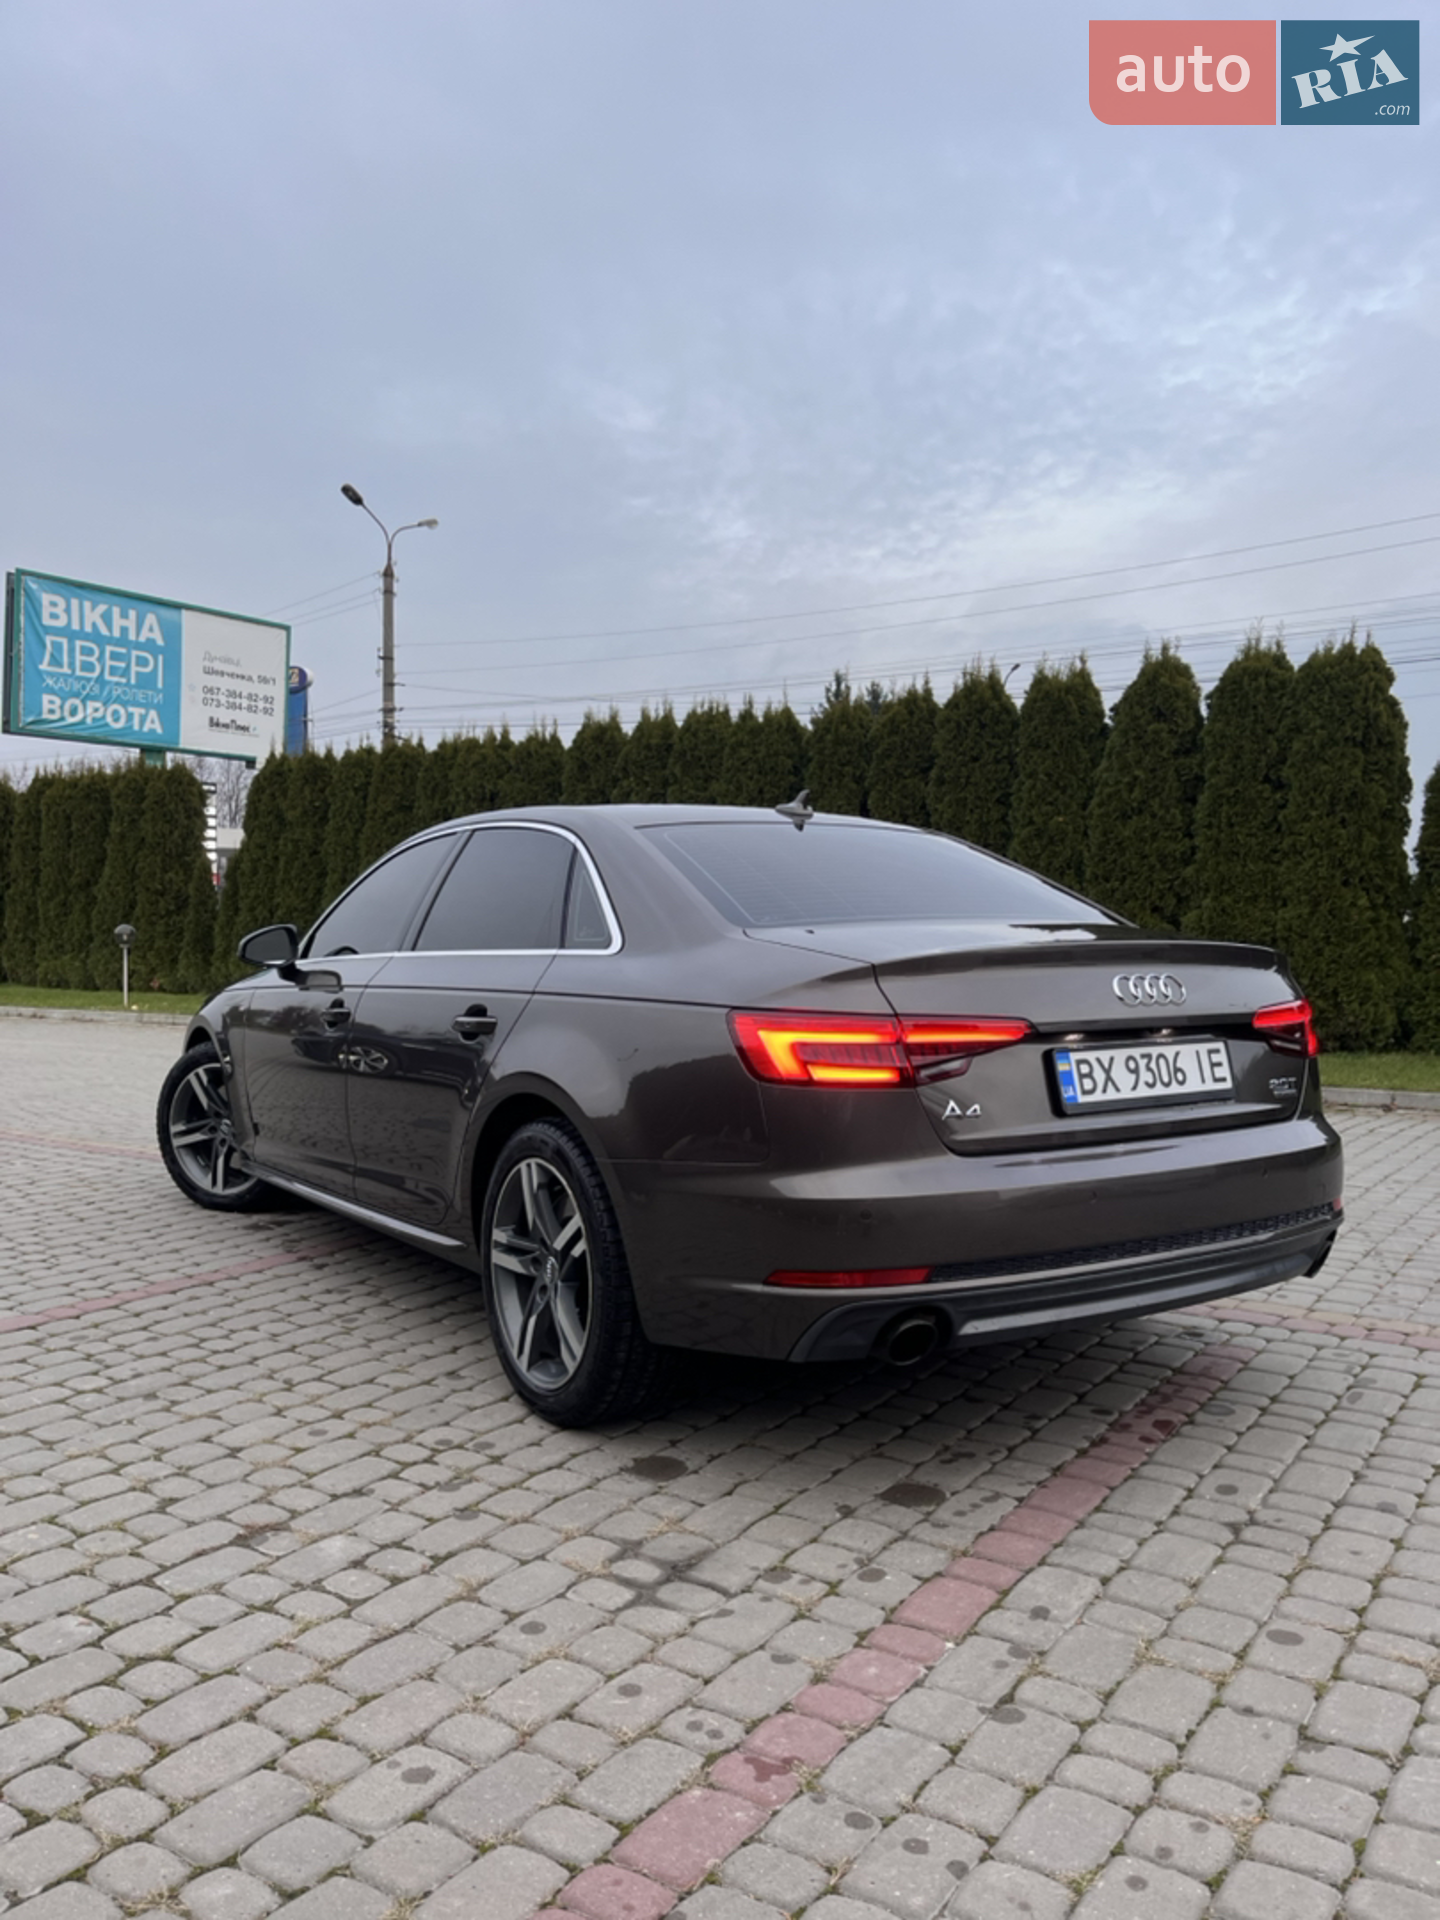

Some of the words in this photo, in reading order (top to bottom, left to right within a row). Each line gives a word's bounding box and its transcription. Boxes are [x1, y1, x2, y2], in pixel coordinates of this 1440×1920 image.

[42, 592, 165, 646] ВІКНА
[38, 634, 164, 689] ДВЕРІ
[113, 685, 164, 705] РОЛЕТИ
[202, 685, 275, 706] 067-384-82-92
[202, 696, 275, 717] 073-384-82-92
[42, 693, 164, 735] ВОРОТА
[1075, 1055, 1121, 1095] BX
[1125, 1050, 1187, 1092] 9306
[1196, 1047, 1228, 1085] IE
[942, 1099, 982, 1120] A4
